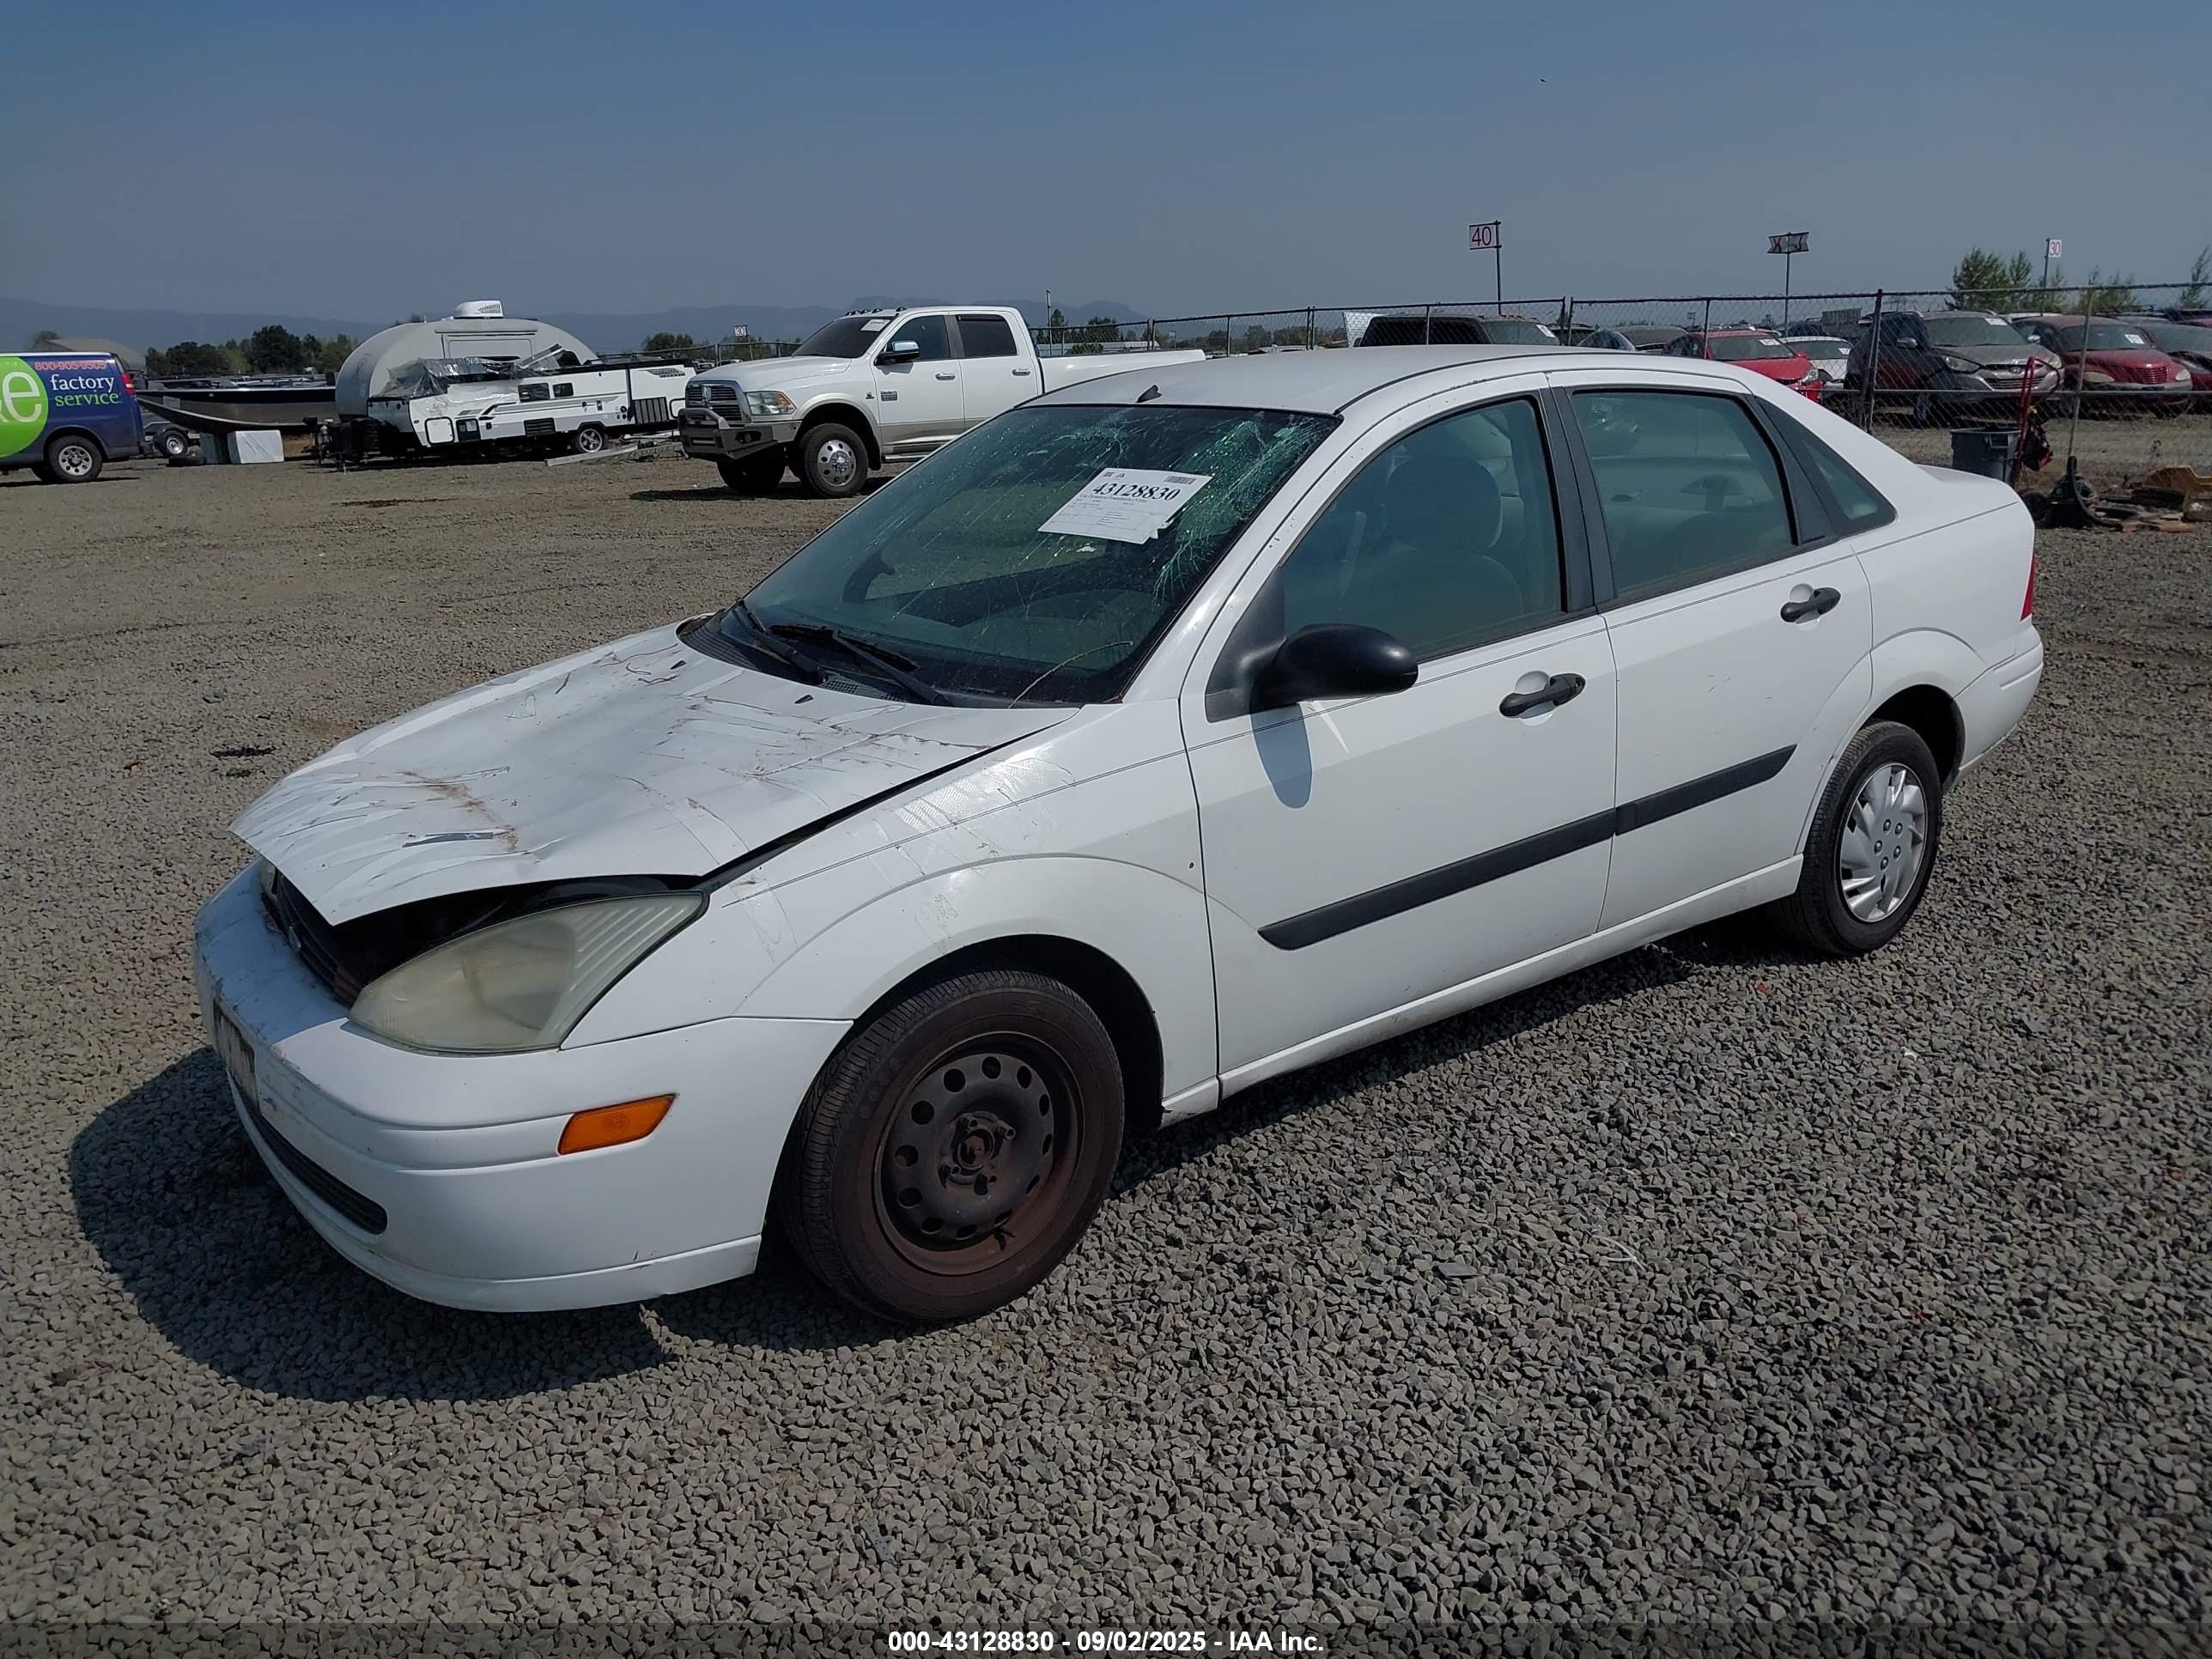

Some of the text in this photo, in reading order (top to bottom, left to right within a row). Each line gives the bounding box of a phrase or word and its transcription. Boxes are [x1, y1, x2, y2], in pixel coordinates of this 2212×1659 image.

[1471, 226, 1492, 246] 40
[2050, 241, 2061, 256] 30
[50, 374, 114, 393] factory
[54, 389, 120, 406] service
[1092, 482, 1182, 501] 43128830
